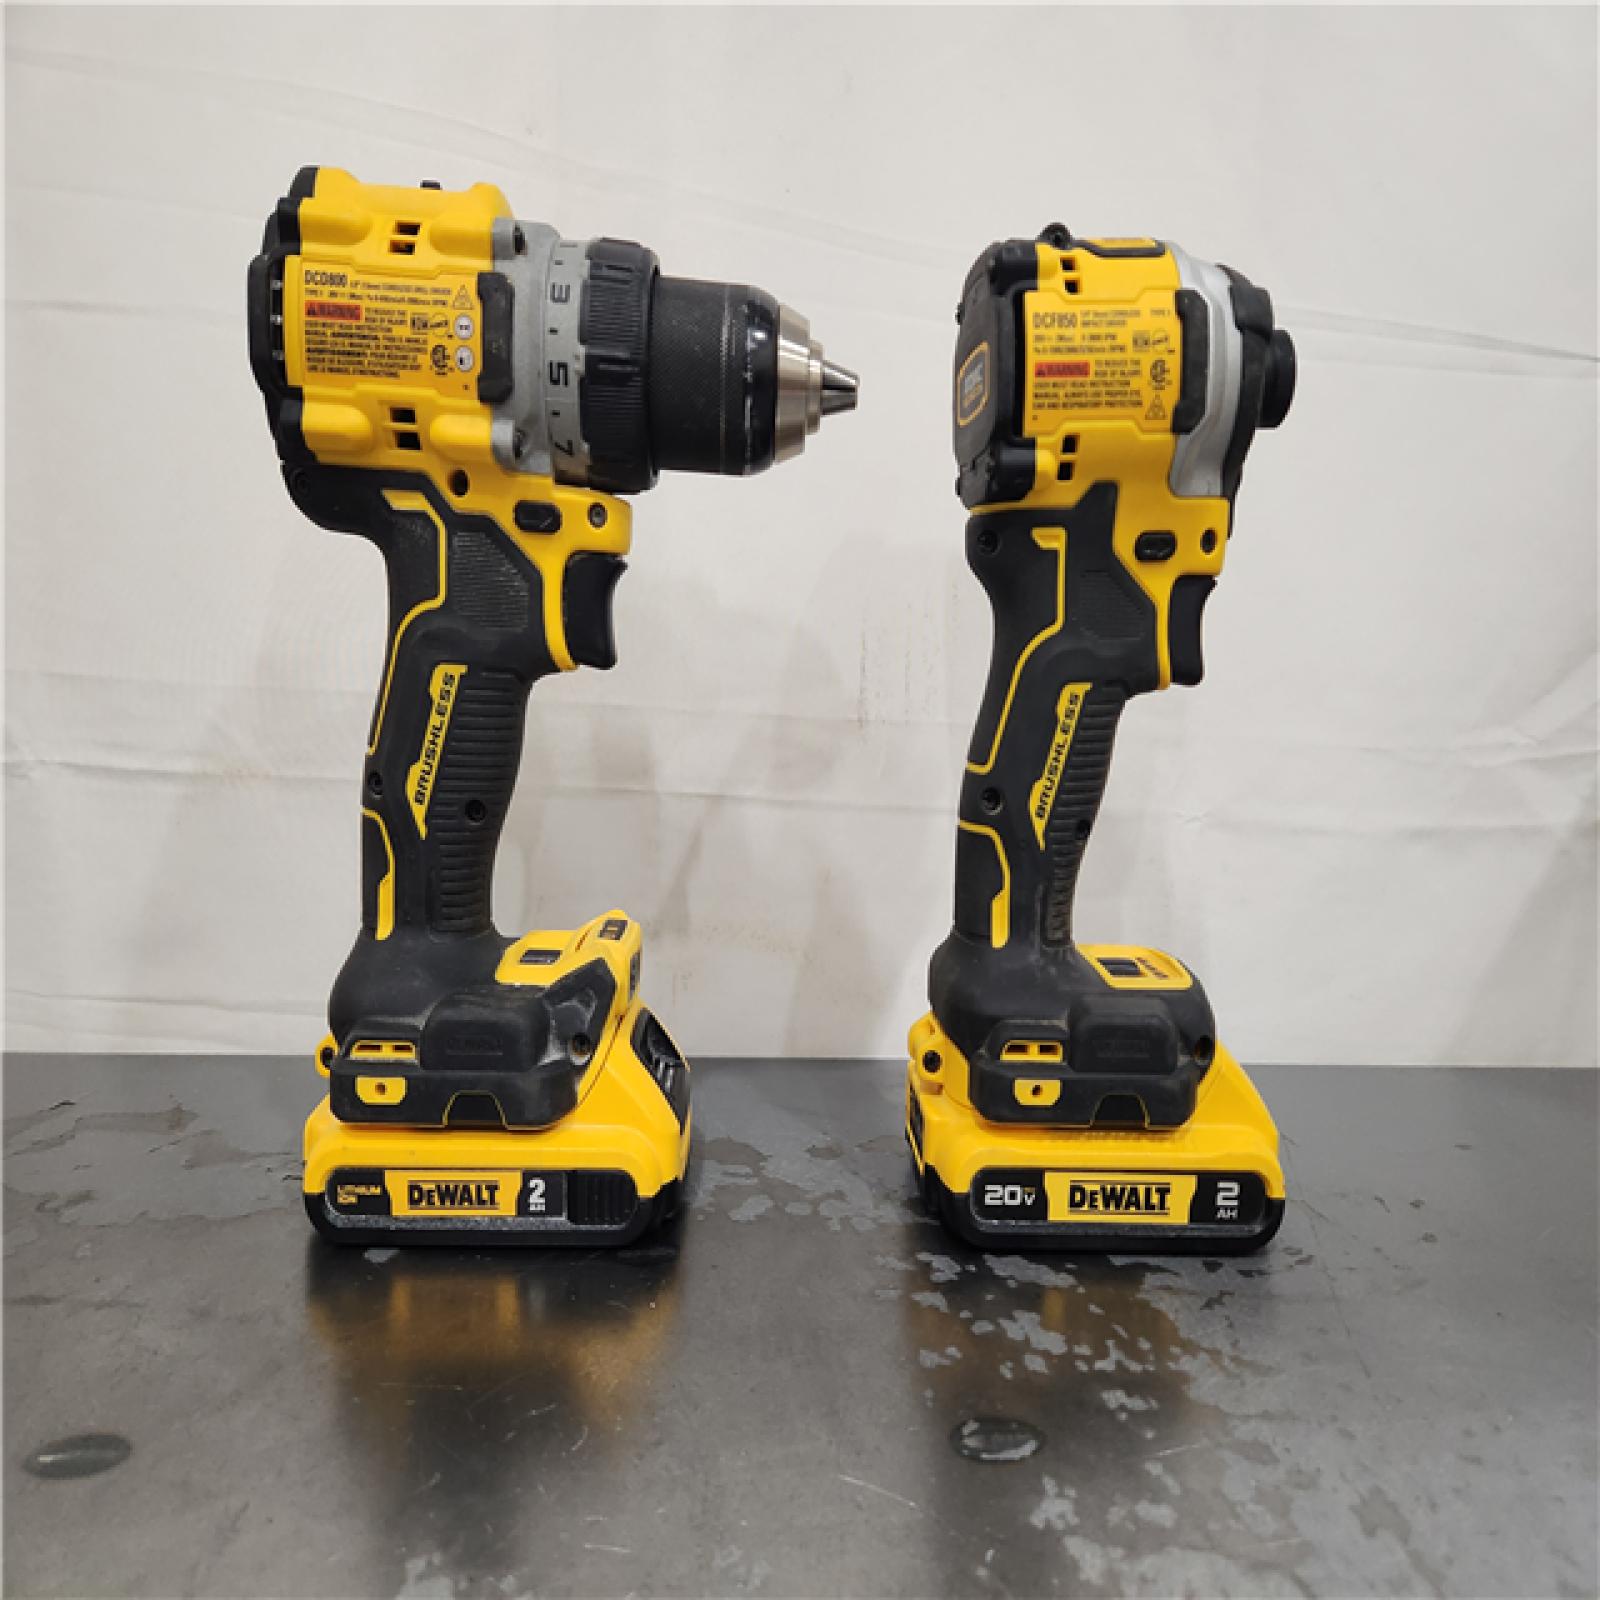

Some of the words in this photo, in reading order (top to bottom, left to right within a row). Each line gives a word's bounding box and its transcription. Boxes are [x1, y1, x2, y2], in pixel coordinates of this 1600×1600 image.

[550, 283, 570, 303] 3
[549, 362, 569, 387] 5
[554, 440, 575, 457] 7
[414, 671, 456, 806] BRUSHLESS
[1035, 691, 1081, 819] BRUSHLESS
[528, 1177, 546, 1201] 2
[1217, 1181, 1240, 1206] 2
